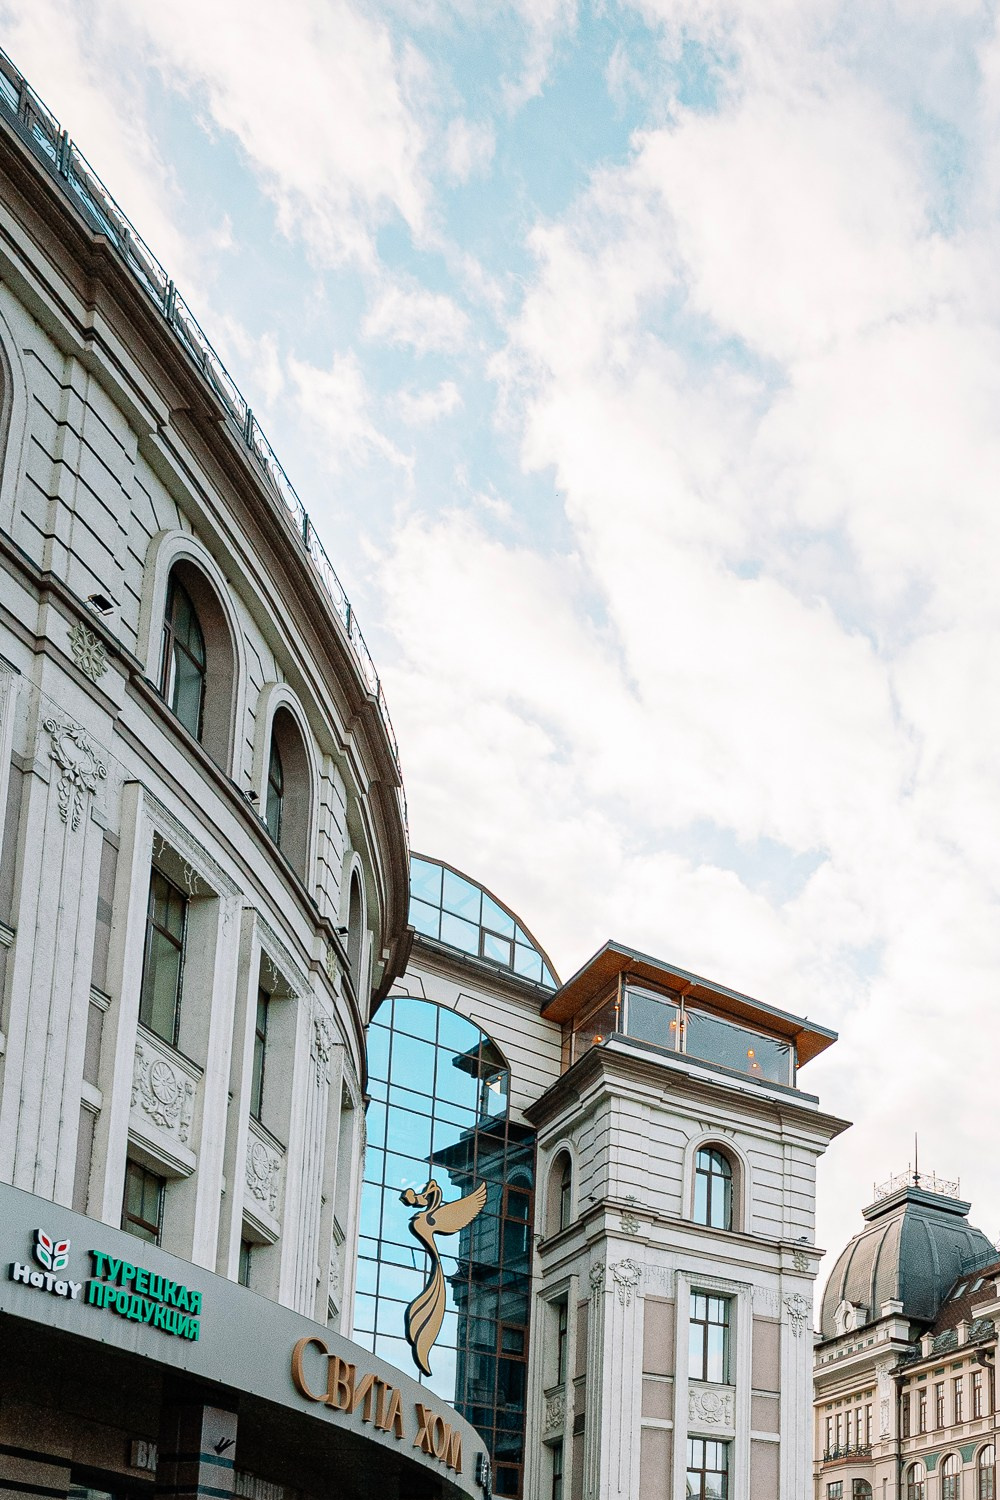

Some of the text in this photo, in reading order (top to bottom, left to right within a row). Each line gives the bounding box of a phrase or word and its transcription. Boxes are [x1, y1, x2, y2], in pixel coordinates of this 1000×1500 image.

[87, 1280, 201, 1341] ПРОДУКЦИЯ
[91, 1250, 202, 1315] ТУРЕЦКАЯ
[291, 1336, 406, 1439] СВИТА
[136, 1439, 158, 1472] ВХ
